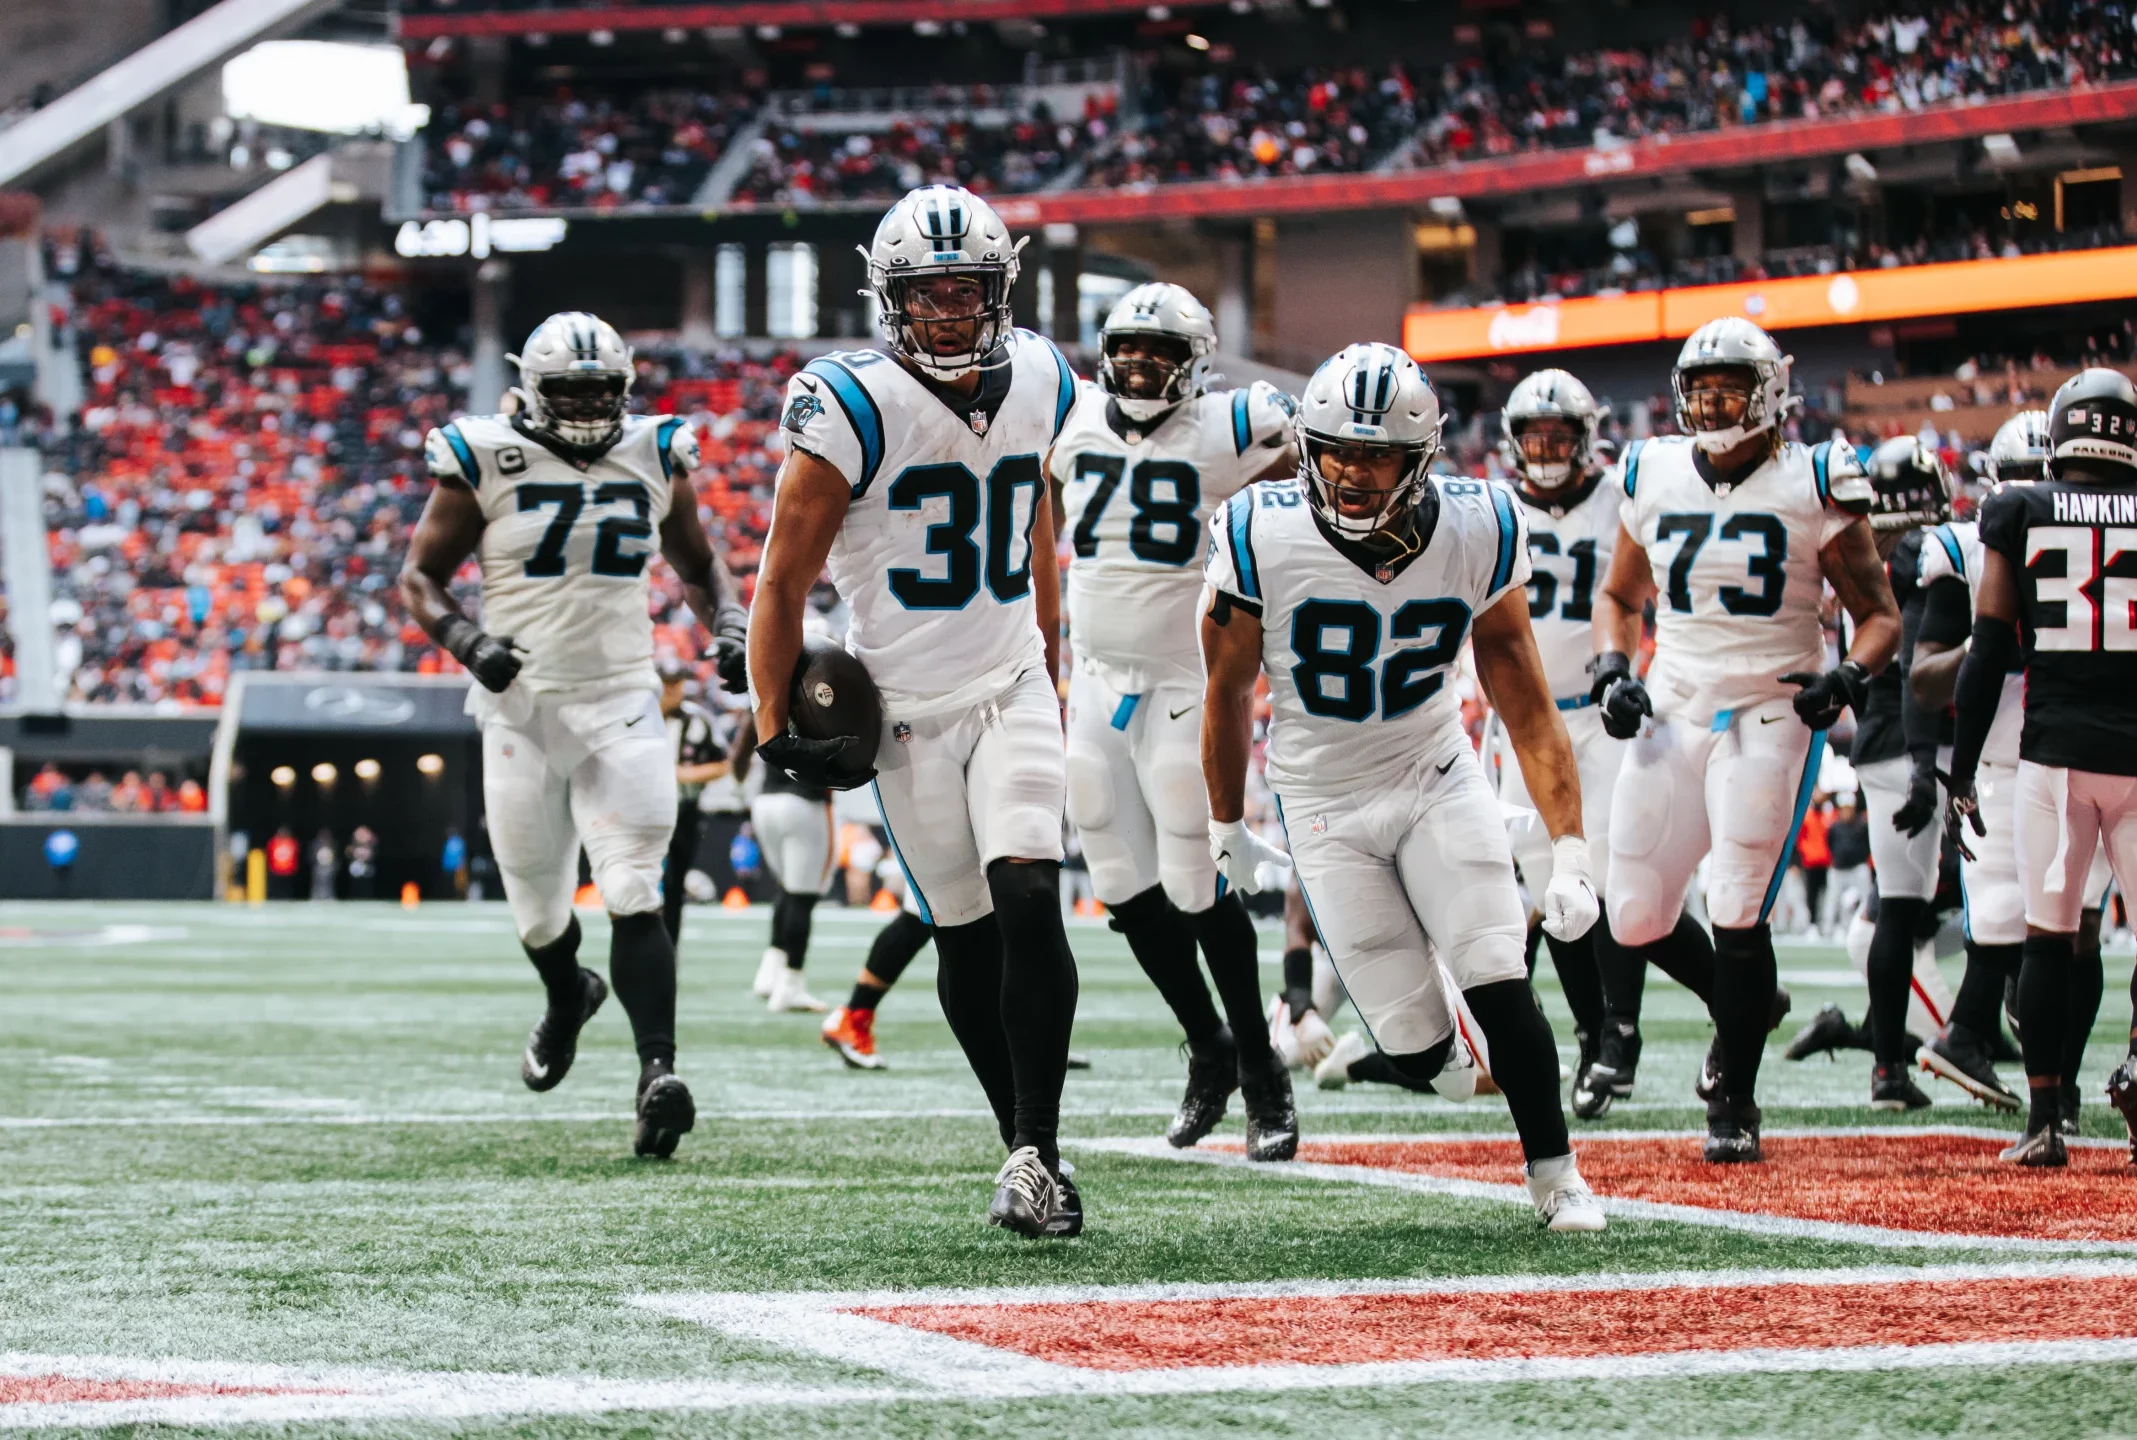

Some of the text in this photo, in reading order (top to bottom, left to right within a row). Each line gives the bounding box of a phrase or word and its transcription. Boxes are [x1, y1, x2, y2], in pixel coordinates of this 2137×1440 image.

[2072, 445, 2133, 461] FALCONS
[2091, 413, 2121, 435] 32
[516, 481, 652, 578] 72
[887, 452, 1047, 610] 30
[1073, 452, 1200, 567] 78
[2053, 492, 2137, 524] HAWKIN
[1524, 530, 1597, 622] 61
[1656, 512, 1787, 617] 73
[1290, 597, 1473, 722] 82
